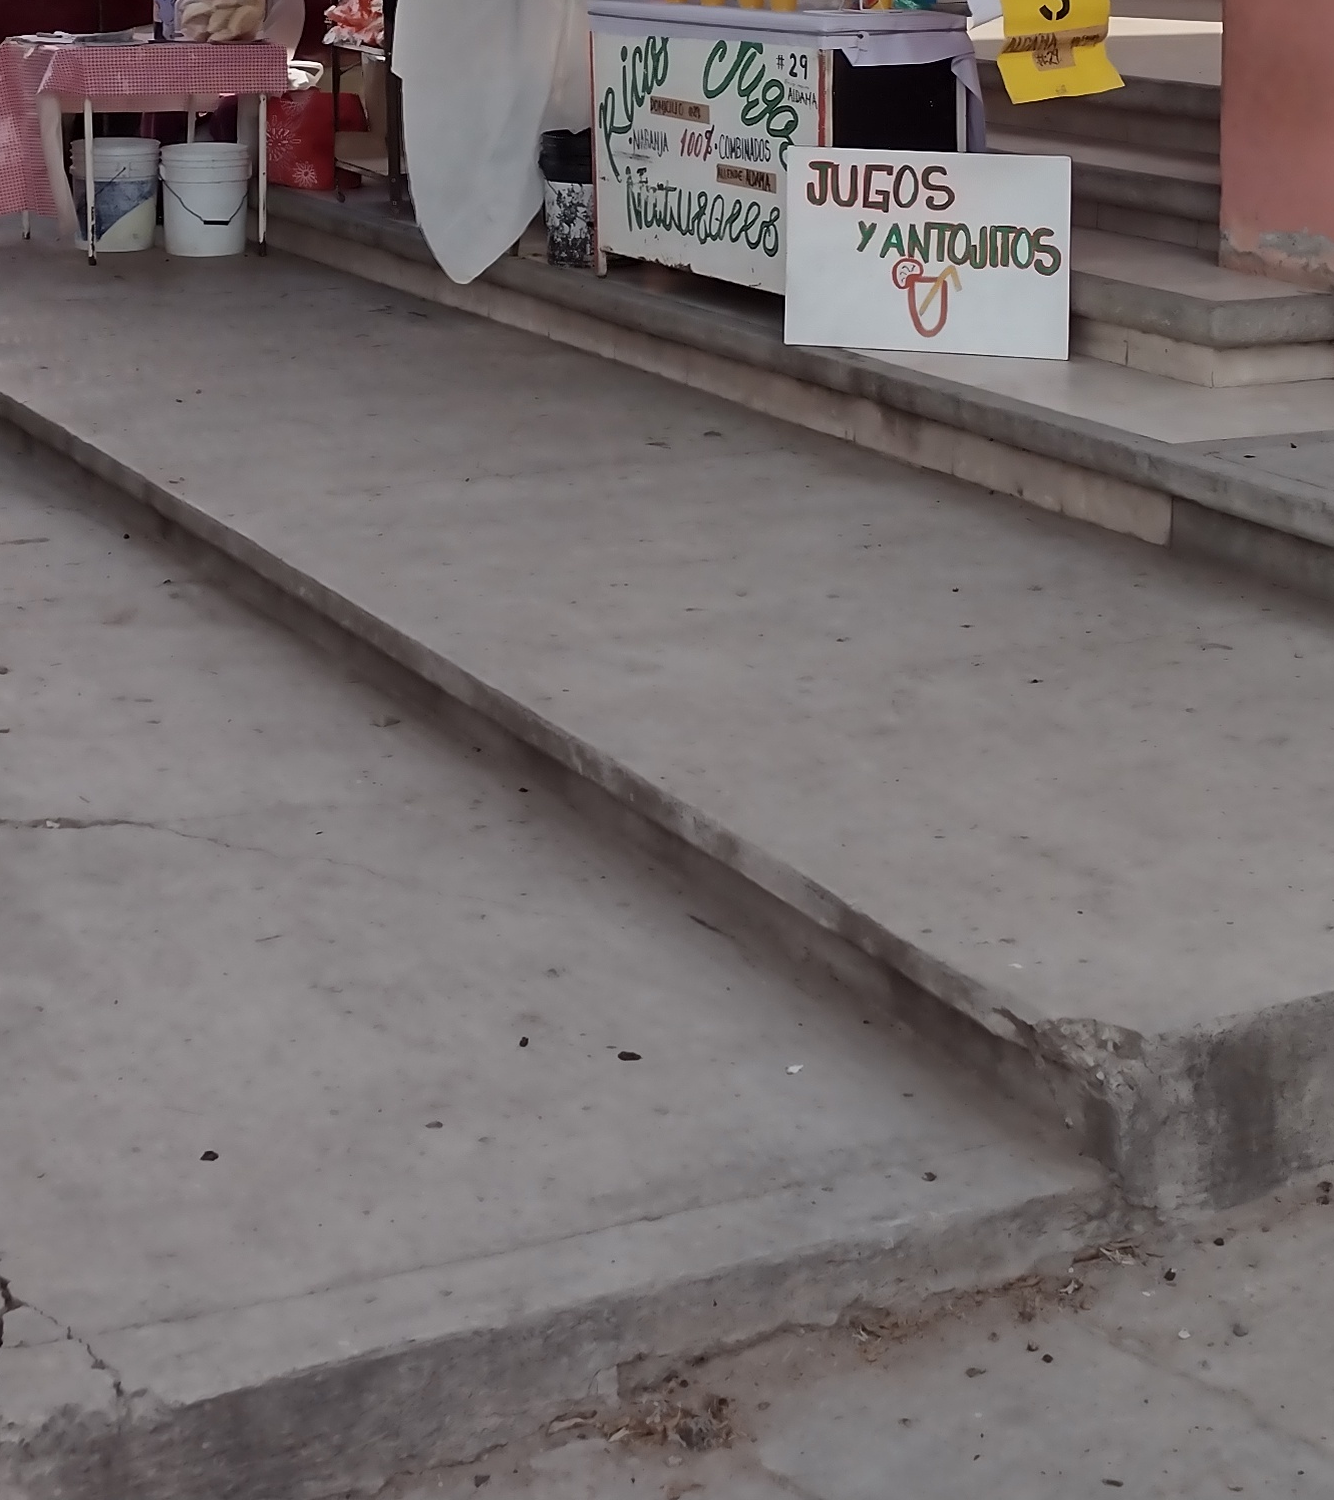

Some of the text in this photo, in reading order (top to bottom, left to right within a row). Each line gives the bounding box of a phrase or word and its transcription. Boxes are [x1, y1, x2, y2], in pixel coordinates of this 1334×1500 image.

[679, 125, 716, 162] 100%
[806, 160, 956, 212] JUGOS
[856, 220, 1062, 277] Y ANTOJITOS
